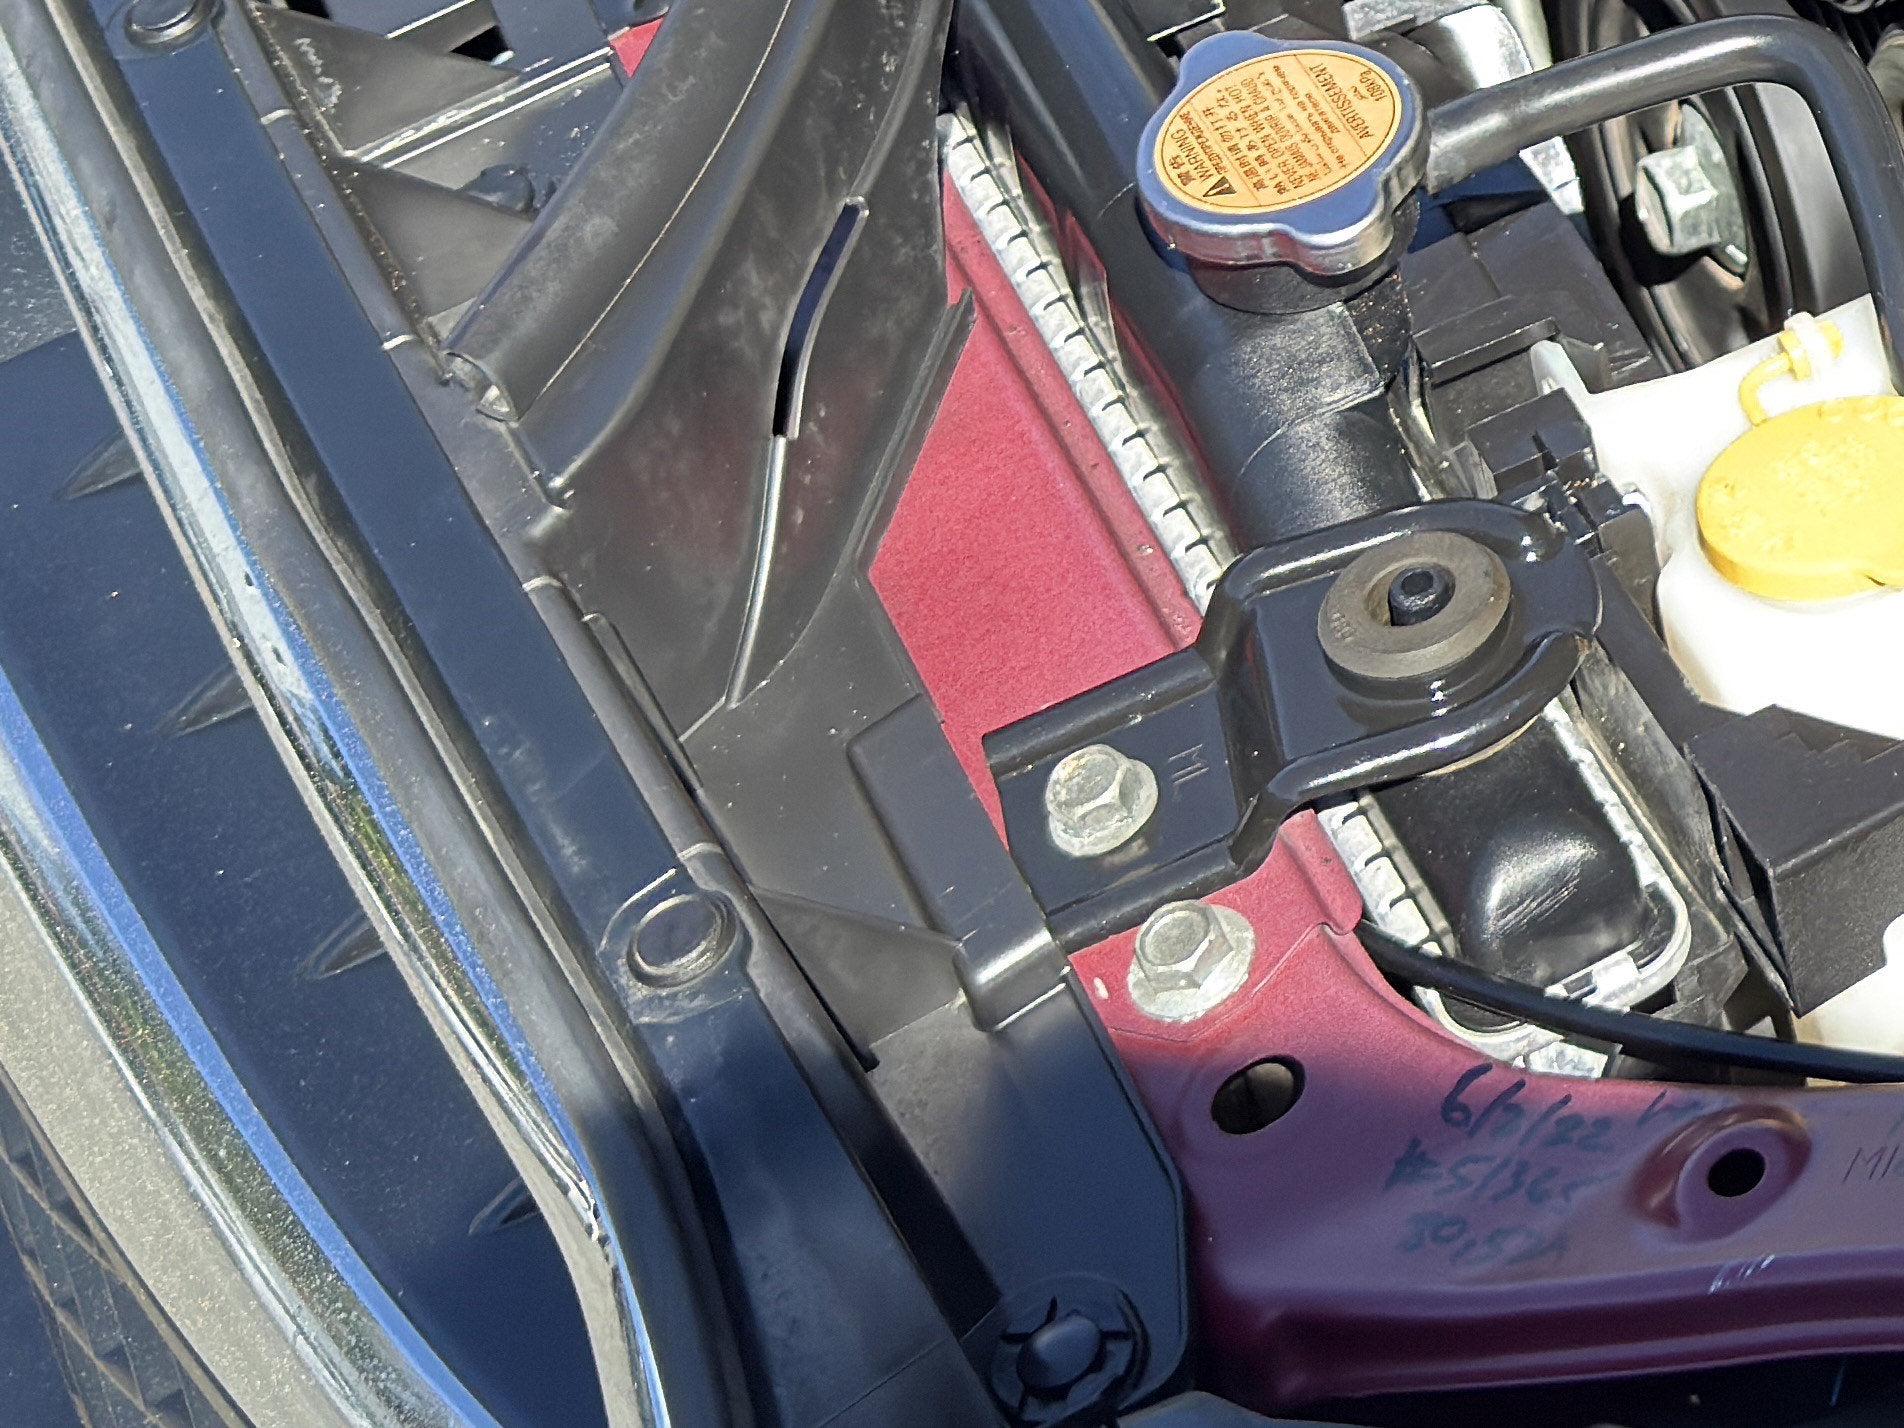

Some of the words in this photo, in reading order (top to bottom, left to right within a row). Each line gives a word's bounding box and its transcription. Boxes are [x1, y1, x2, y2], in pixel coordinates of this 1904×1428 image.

[1223, 84, 1247, 103] HOT
[1238, 77, 1267, 105] CHAUD
[1307, 61, 1375, 140] AVERTISSEMENT
[1355, 69, 1389, 102] 108kPa
[1237, 103, 1268, 133] WHEN
[1167, 128, 1217, 182] WARNING
[1257, 133, 1287, 159] OPEN
[1275, 159, 1308, 189] NEVER
